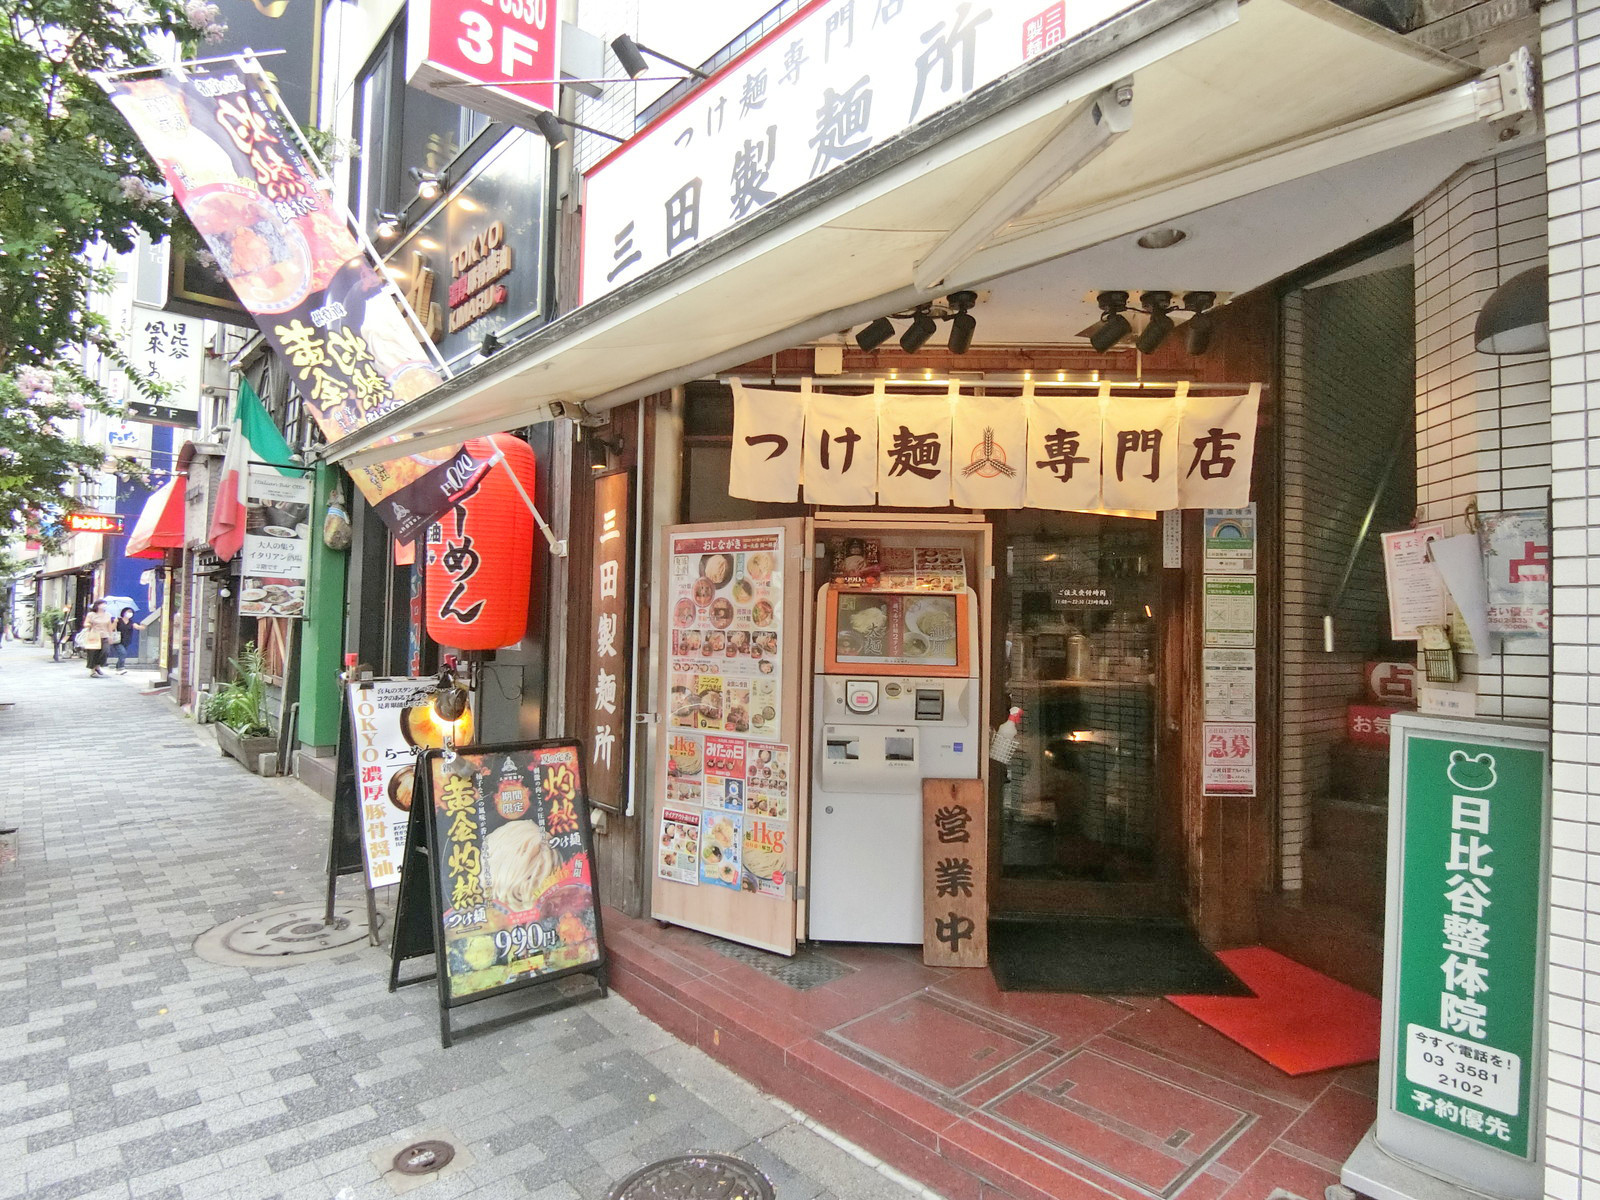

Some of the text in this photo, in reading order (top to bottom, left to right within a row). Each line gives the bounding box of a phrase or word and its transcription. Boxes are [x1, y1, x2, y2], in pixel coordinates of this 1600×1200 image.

[457, 10, 538, 77] 3F
[607, 3, 993, 282] 三田製麺所
[449, 221, 504, 279] TOKYO
[169, 322, 190, 361] 日比谷
[745, 426, 1241, 483] つけ麺 専門店
[258, 541, 295, 551] 大人の集う
[438, 483, 487, 625] ーめん
[702, 539, 740, 551] おしながき
[593, 508, 621, 771] 三田製麺所
[356, 688, 380, 763] TOKYO
[705, 742, 745, 760] みたの日
[1208, 734, 1250, 758] 急募
[501, 790, 523, 802] 期間
[502, 802, 524, 815] 限定
[544, 765, 579, 835] 灼熱
[361, 766, 395, 878] 濃厚豚骨醤油
[549, 832, 582, 849] つけ麺
[752, 821, 785, 853] 1kg
[441, 775, 484, 912] 黄金灼熱
[934, 804, 975, 953] 営業中
[448, 906, 488, 928] つけ麺
[1440, 794, 1494, 1040] 日比谷整体院
[494, 921, 557, 959] 990円
[1414, 1031, 1511, 1070] 今すぐ電話を!
[1423, 1052, 1499, 1085] 03 3581
[1438, 1073, 1483, 1097] 2102
[1411, 1089, 1511, 1142] 予約優先
